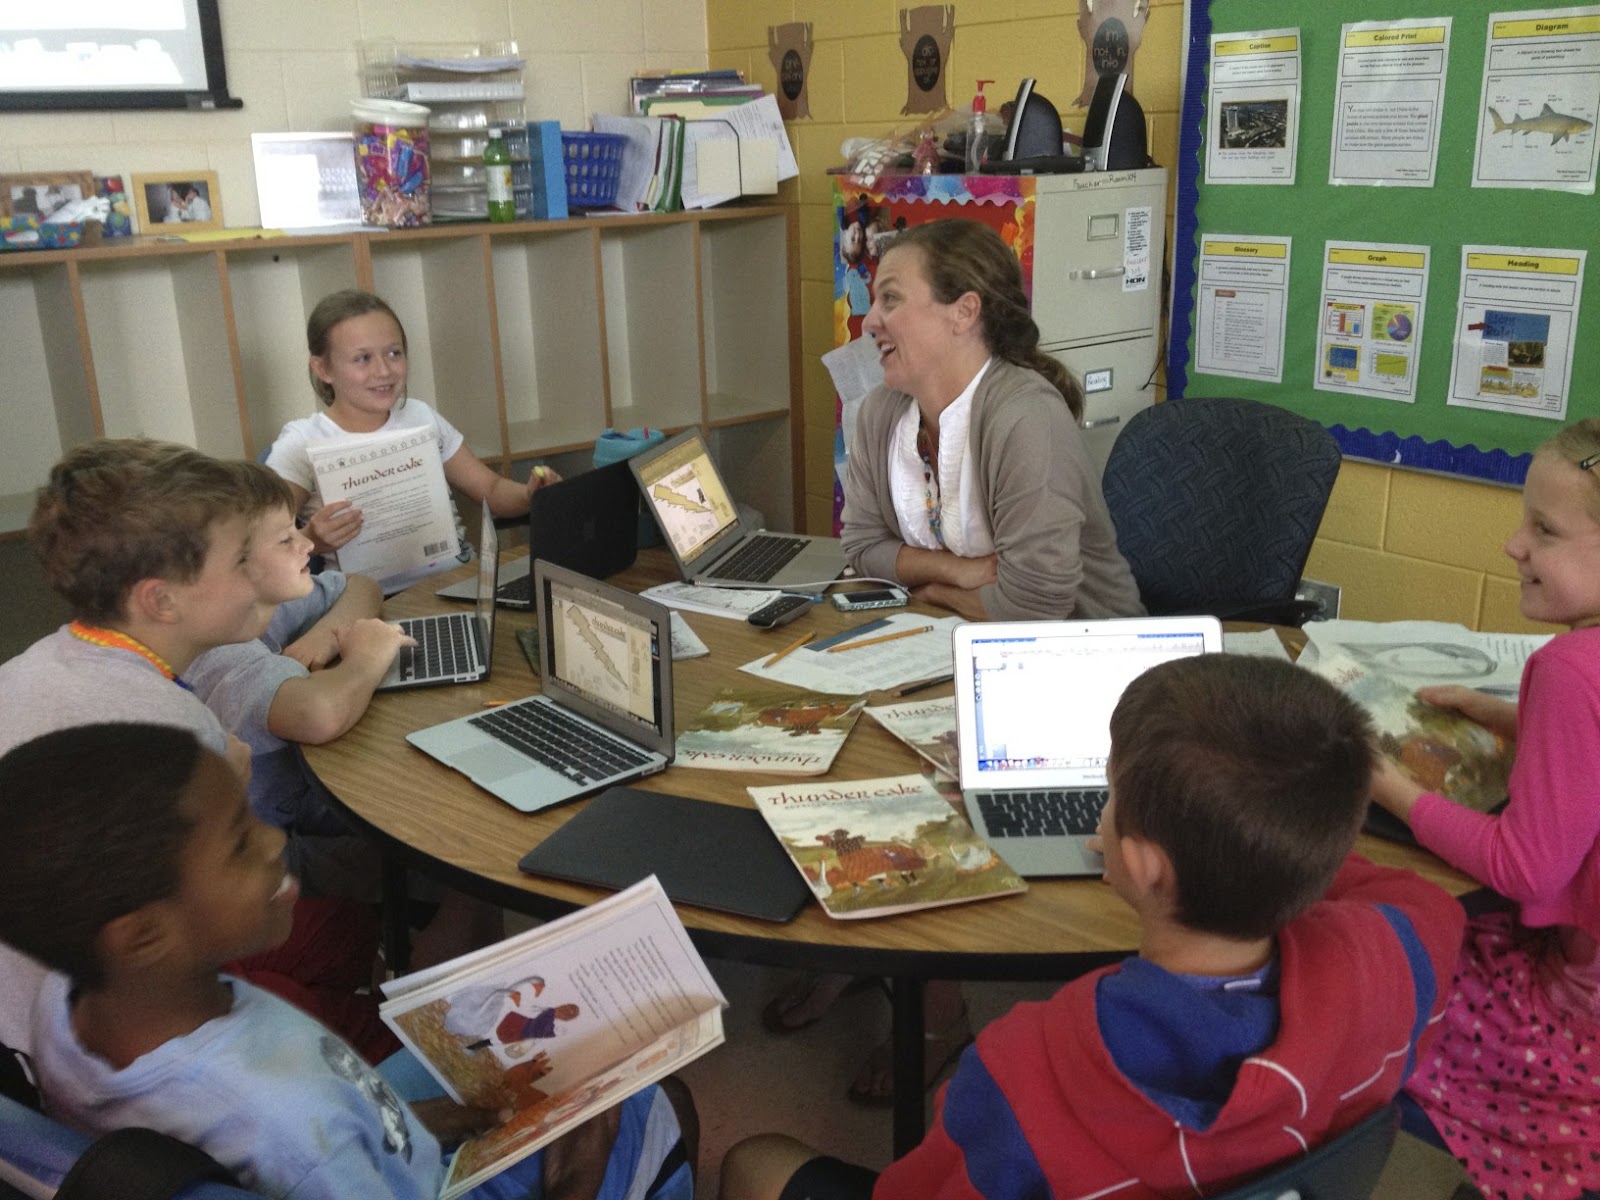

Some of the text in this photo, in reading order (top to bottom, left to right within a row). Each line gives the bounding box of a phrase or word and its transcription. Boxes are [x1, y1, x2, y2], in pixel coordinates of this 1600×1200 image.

[1535, 23, 1569, 32] Diagram
[1373, 33, 1400, 41] Colored
[1249, 43, 1272, 51] Caption
[1233, 246, 1259, 255] Glossary
[1367, 254, 1388, 262] Graph
[1507, 259, 1540, 269] Heading
[883, 704, 955, 718] thunde
[767, 788, 872, 806] thunder
[873, 783, 923, 798] cake
